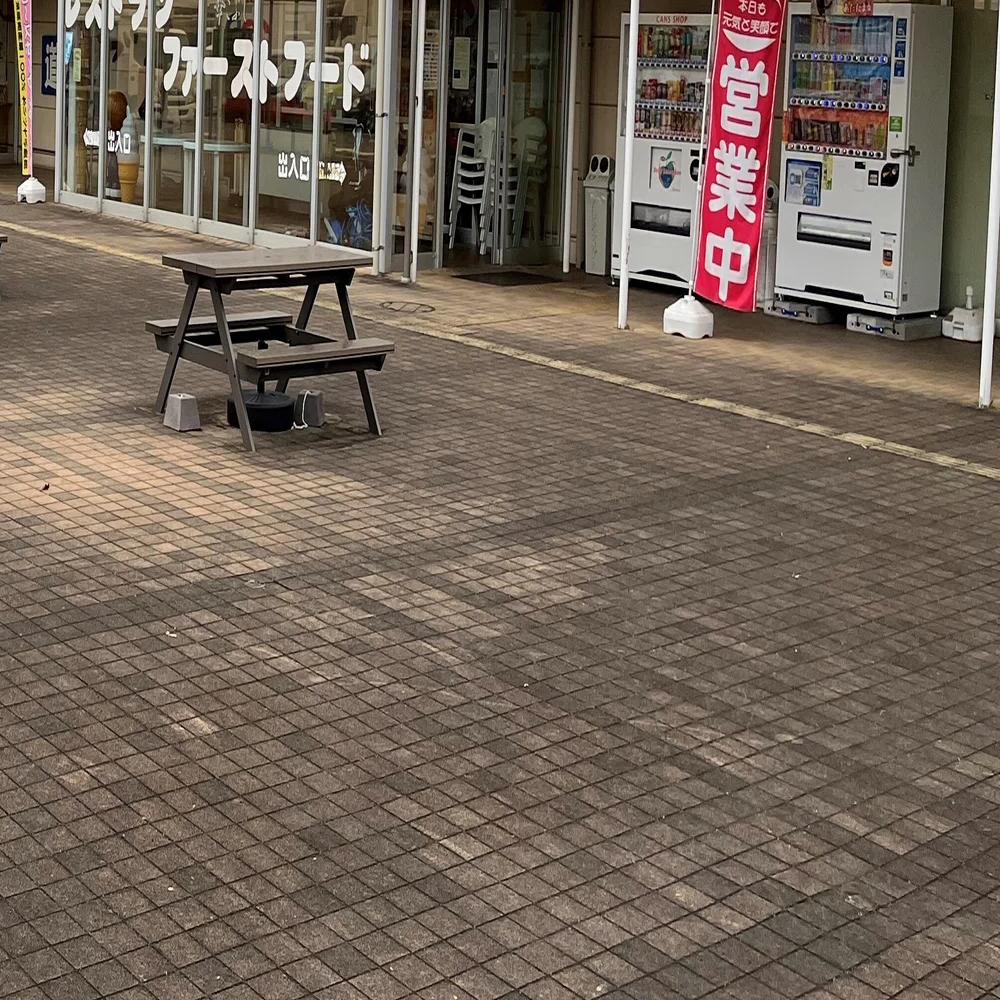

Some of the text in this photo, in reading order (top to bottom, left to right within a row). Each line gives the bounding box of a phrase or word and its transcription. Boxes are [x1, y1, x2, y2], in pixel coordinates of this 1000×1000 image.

[656, 15, 688, 24] CANS SHOP
[722, 10, 779, 35] 元気と笑顔で
[162, 35, 370, 112] ファーストフード
[107, 129, 131, 155] 出入口
[278, 151, 310, 181] 出入口
[704, 53, 769, 303] 営業中
